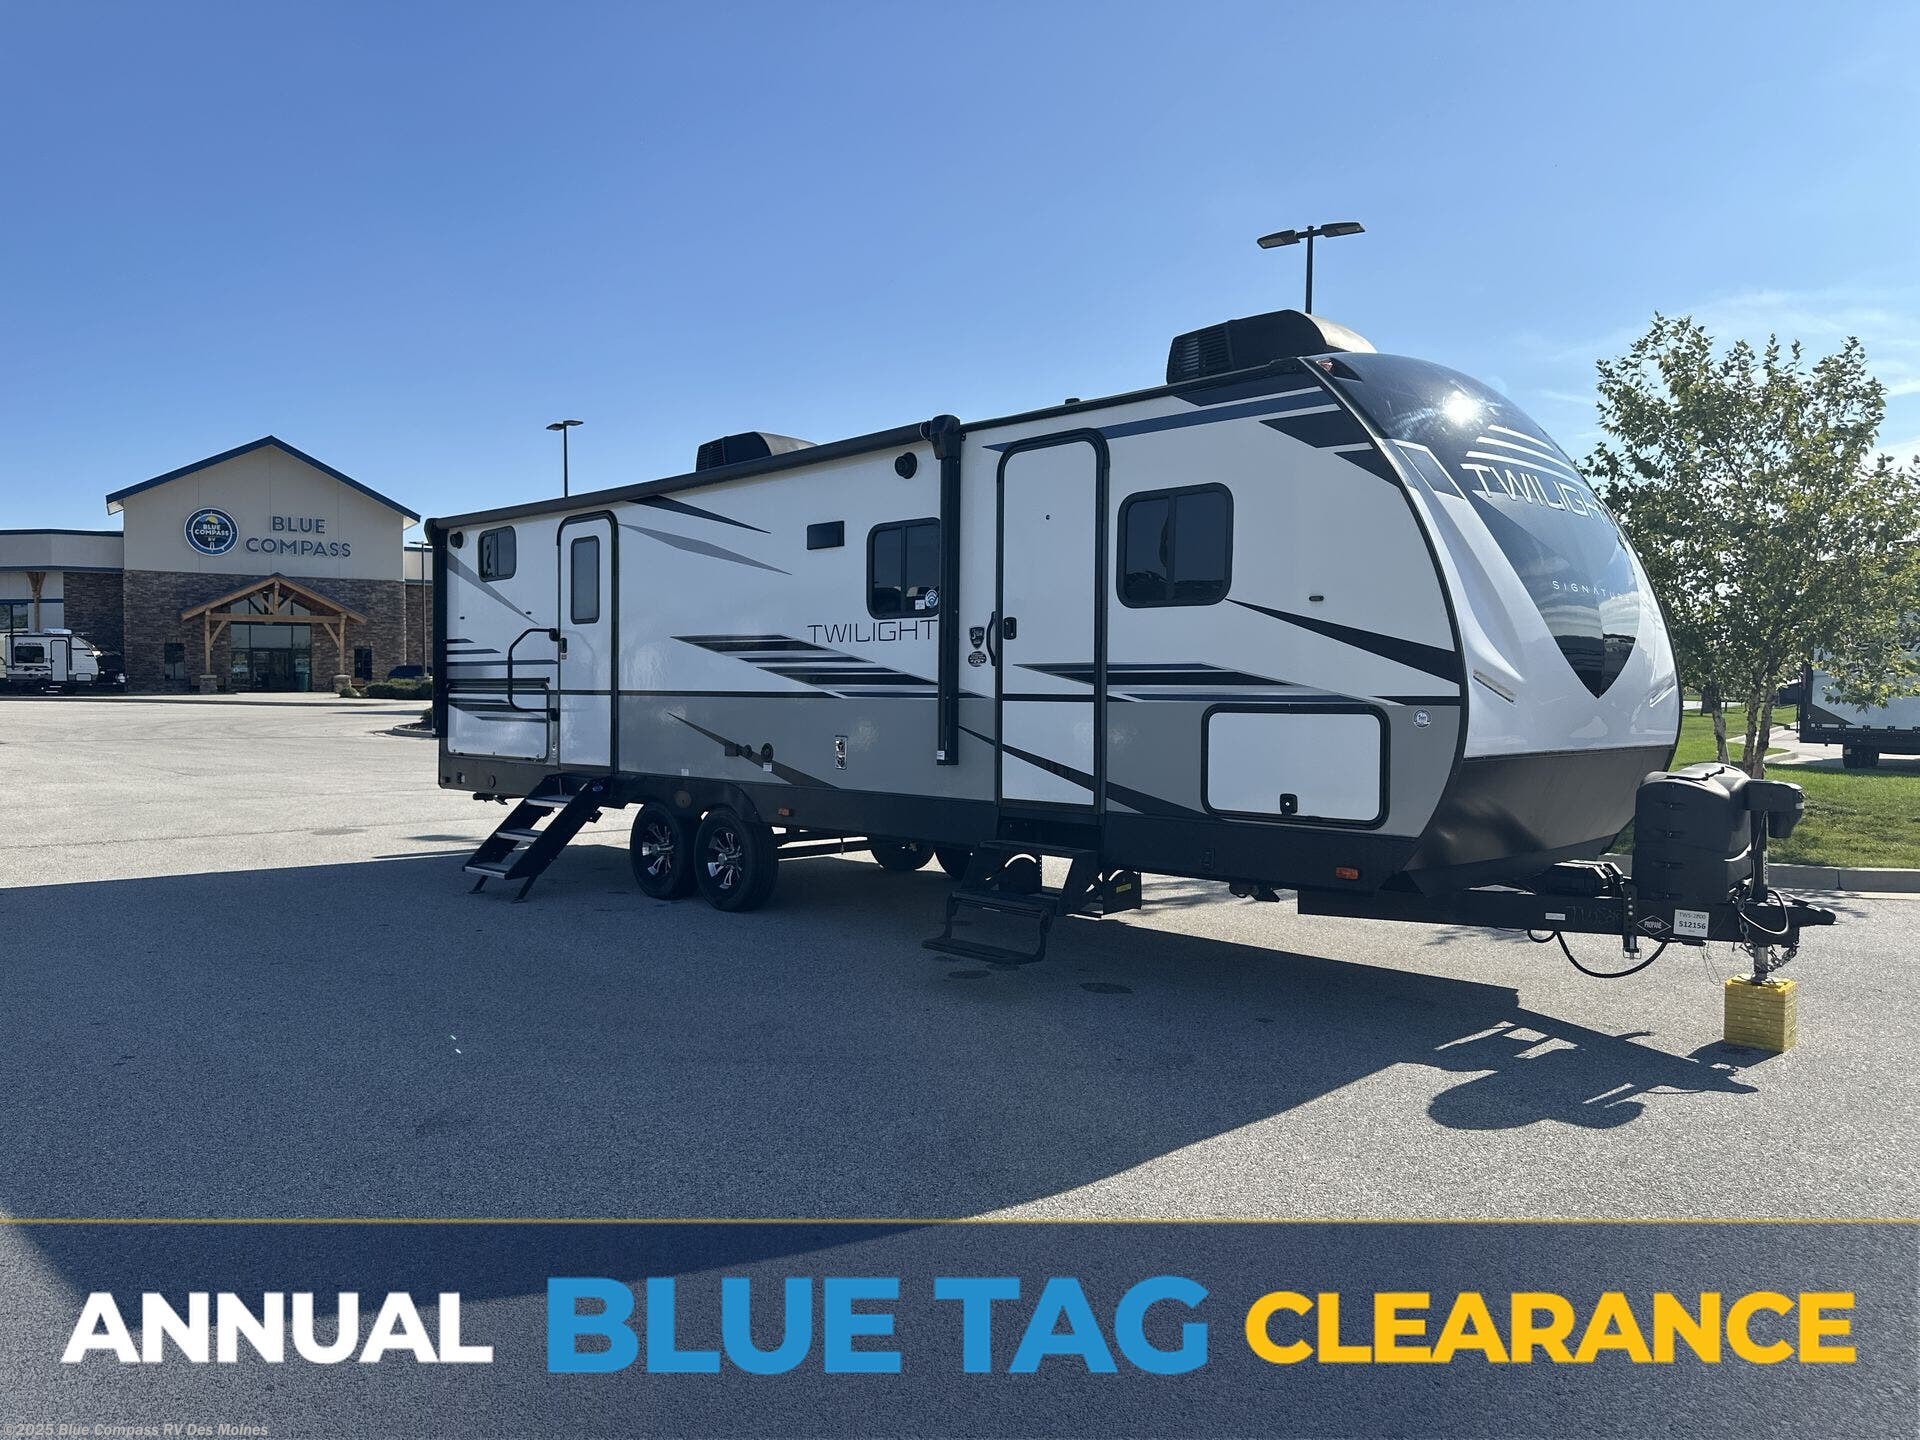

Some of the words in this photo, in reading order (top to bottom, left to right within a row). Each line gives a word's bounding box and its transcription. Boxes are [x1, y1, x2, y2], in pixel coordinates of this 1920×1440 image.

[272, 516, 326, 534] BLUE
[245, 537, 352, 558] COMPASS
[1552, 580, 1626, 600] SIGNATU
[807, 619, 939, 643] TWILIGHT
[1644, 921, 1662, 929] PROPANE
